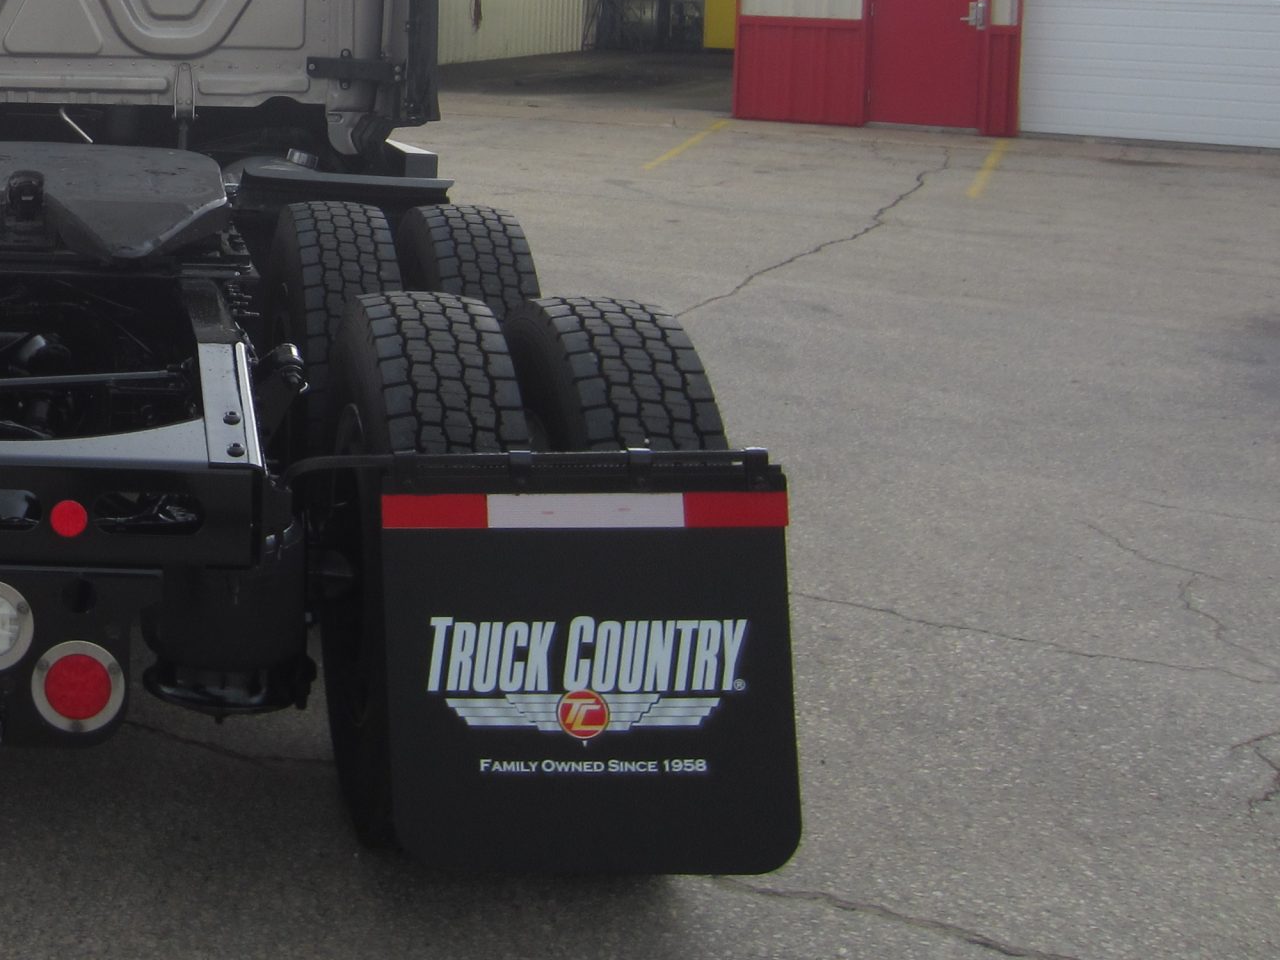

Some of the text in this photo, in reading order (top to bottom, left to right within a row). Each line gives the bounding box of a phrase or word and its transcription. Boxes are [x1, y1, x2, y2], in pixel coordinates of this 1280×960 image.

[427, 615, 748, 692] TRUCK COUNTRY
[479, 758, 708, 772] FAMILY OWNED SINCE 1958
